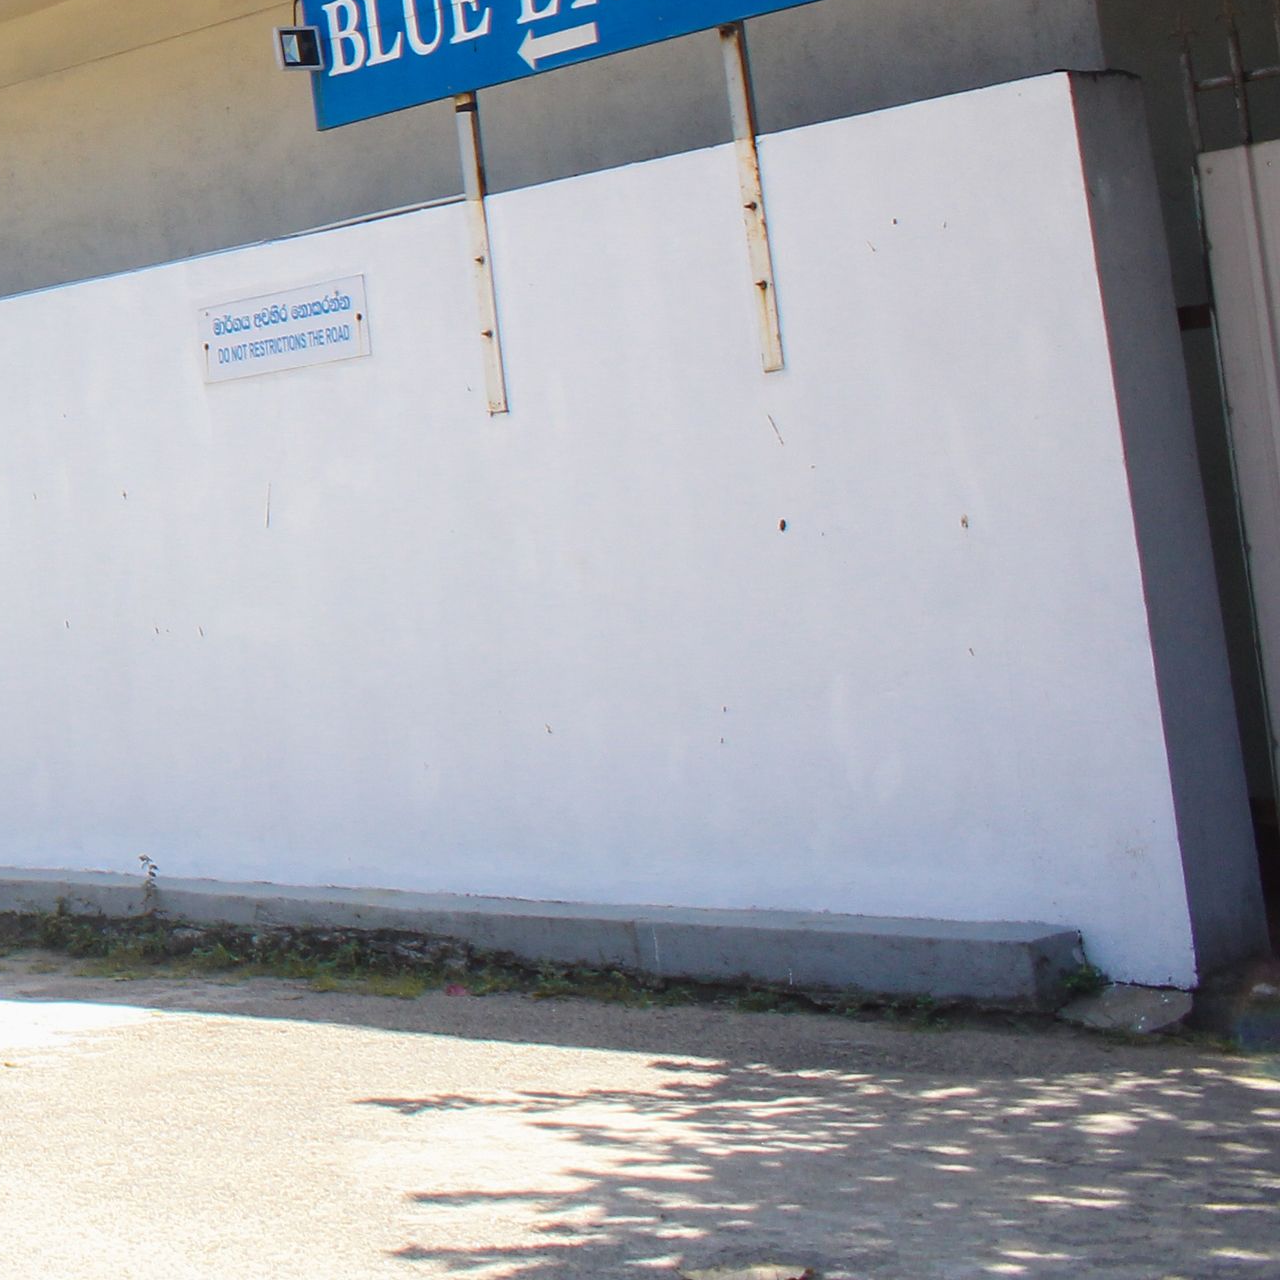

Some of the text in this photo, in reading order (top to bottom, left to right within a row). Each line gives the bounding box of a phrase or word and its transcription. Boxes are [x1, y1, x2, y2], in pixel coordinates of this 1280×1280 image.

[218, 324, 350, 364] DO NOT RESTRICTIONS THE ROAD
